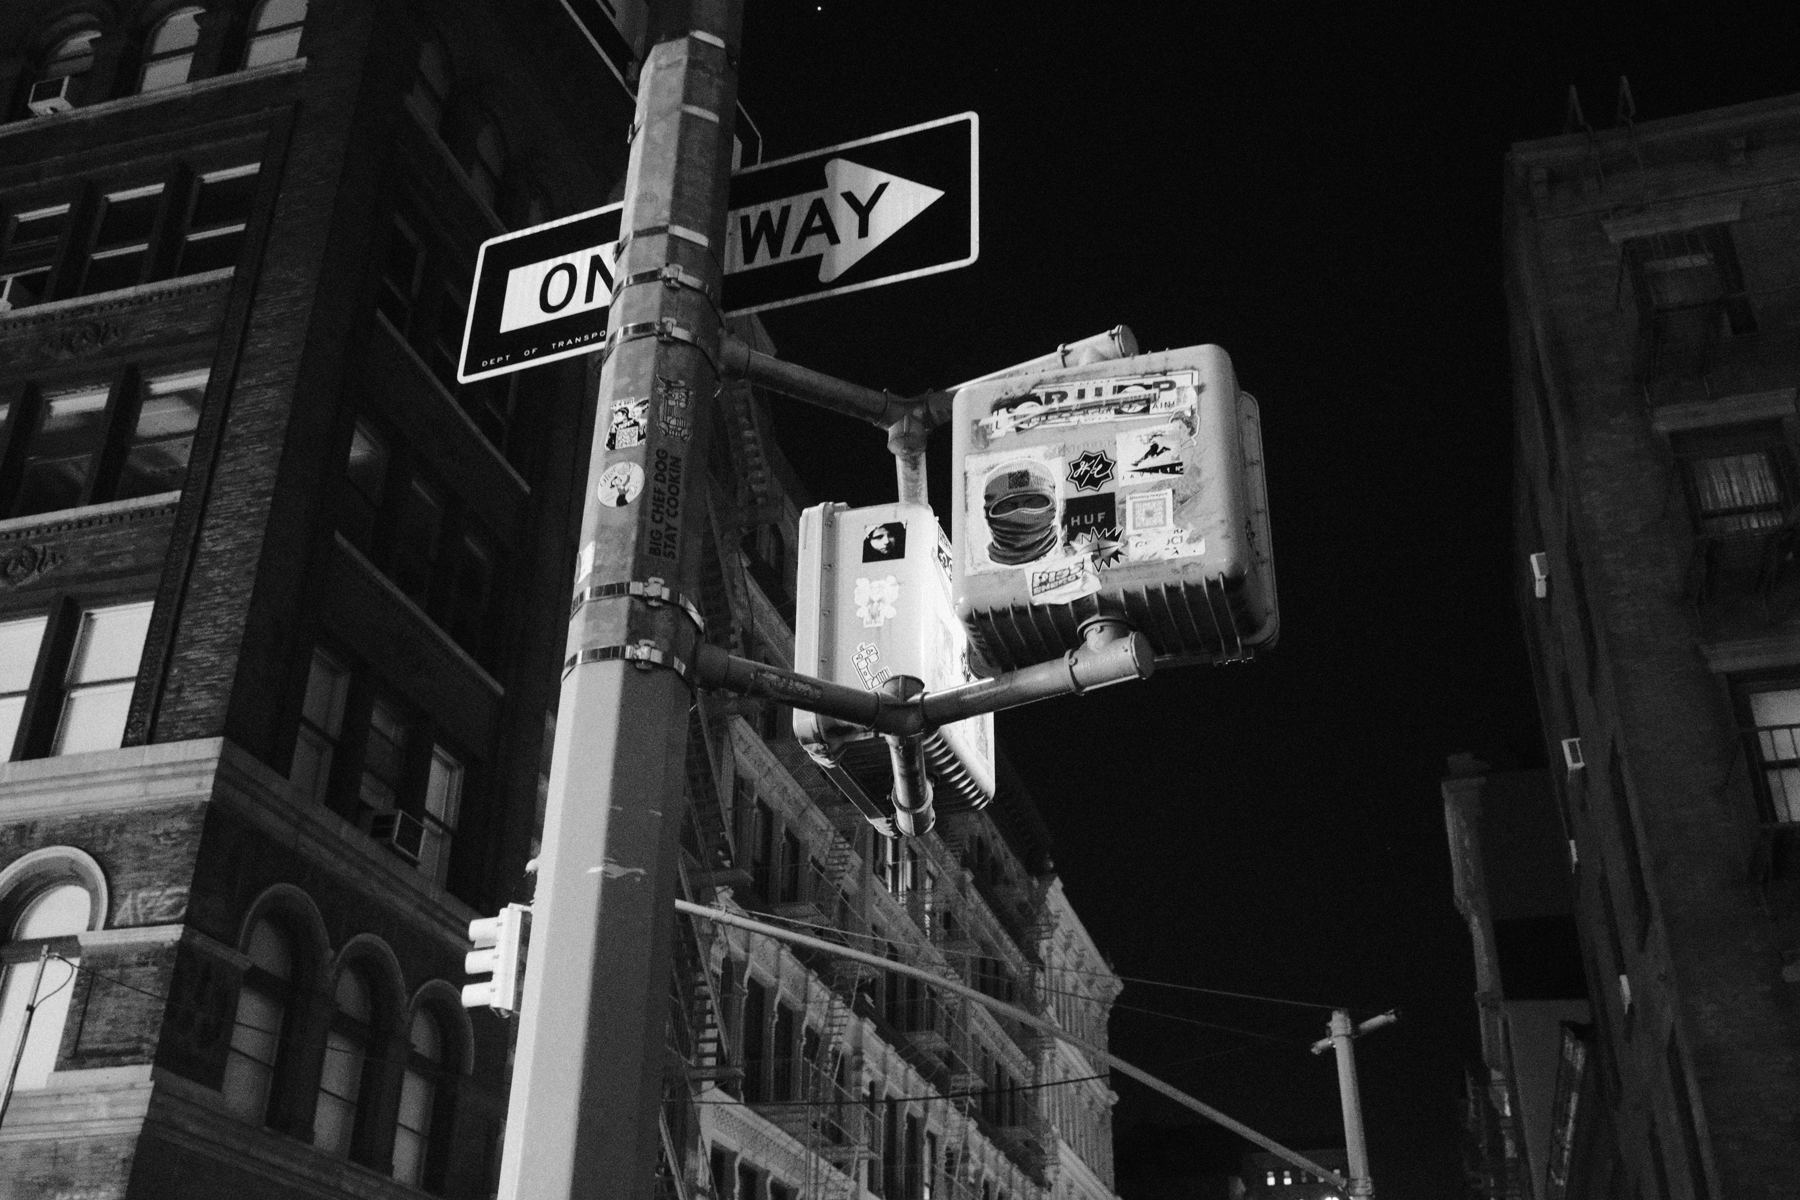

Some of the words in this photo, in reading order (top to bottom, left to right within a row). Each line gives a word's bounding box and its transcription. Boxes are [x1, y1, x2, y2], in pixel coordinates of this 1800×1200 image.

[740, 181, 890, 265] WAY
[481, 355, 511, 367] DEPT
[523, 347, 539, 357] OF
[551, 330, 606, 349] TRANSPO
[654, 449, 669, 484] DOG
[651, 487, 666, 524] CHEF
[666, 456, 682, 518] COOKIN
[1071, 512, 1106, 527] HUF
[649, 529, 663, 557] BIG
[663, 522, 679, 560] STAY
